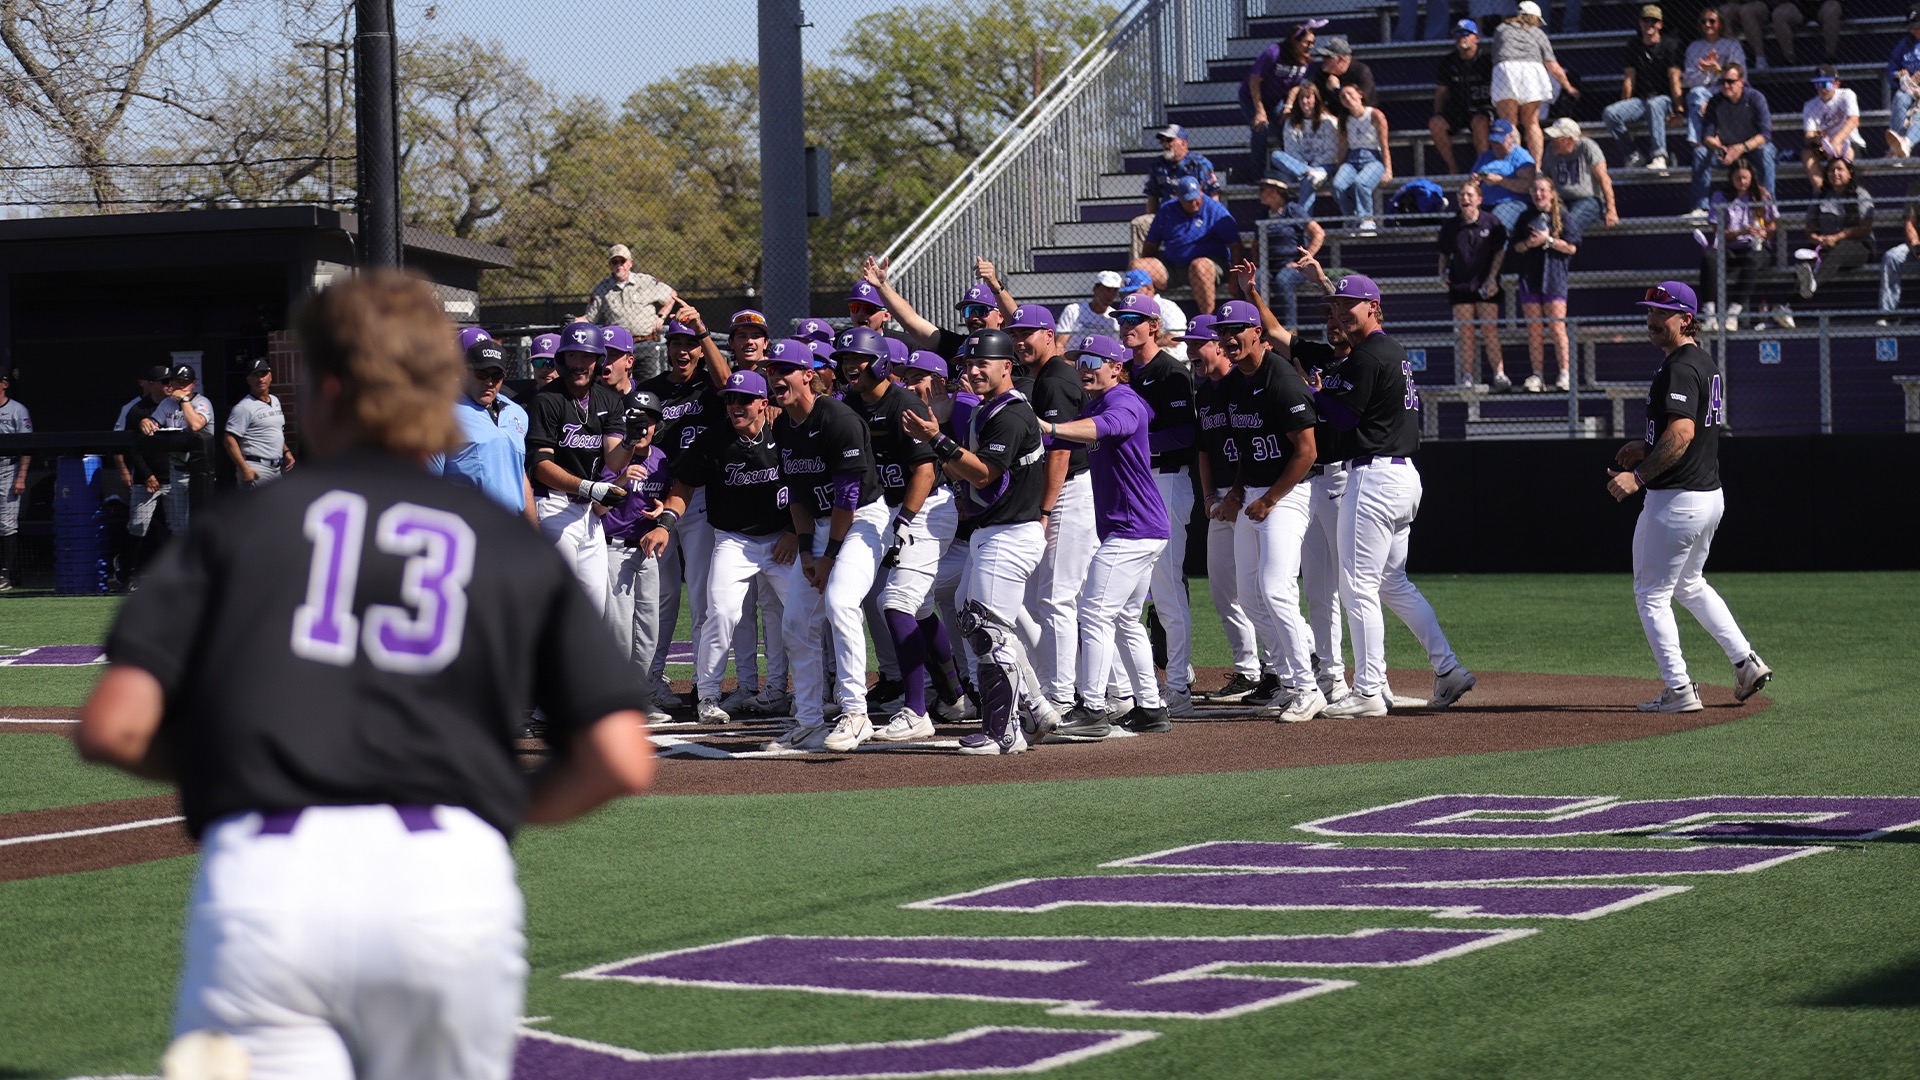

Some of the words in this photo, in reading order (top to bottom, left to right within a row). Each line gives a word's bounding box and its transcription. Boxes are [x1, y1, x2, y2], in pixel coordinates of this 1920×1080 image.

[1704, 374, 1722, 427] 14
[1200, 406, 1228, 431] Texan
[559, 423, 602, 448] Texa
[1251, 434, 1281, 461] 31
[1223, 438, 1240, 462] 4
[776, 486, 789, 510] 8
[290, 489, 476, 674] 13
